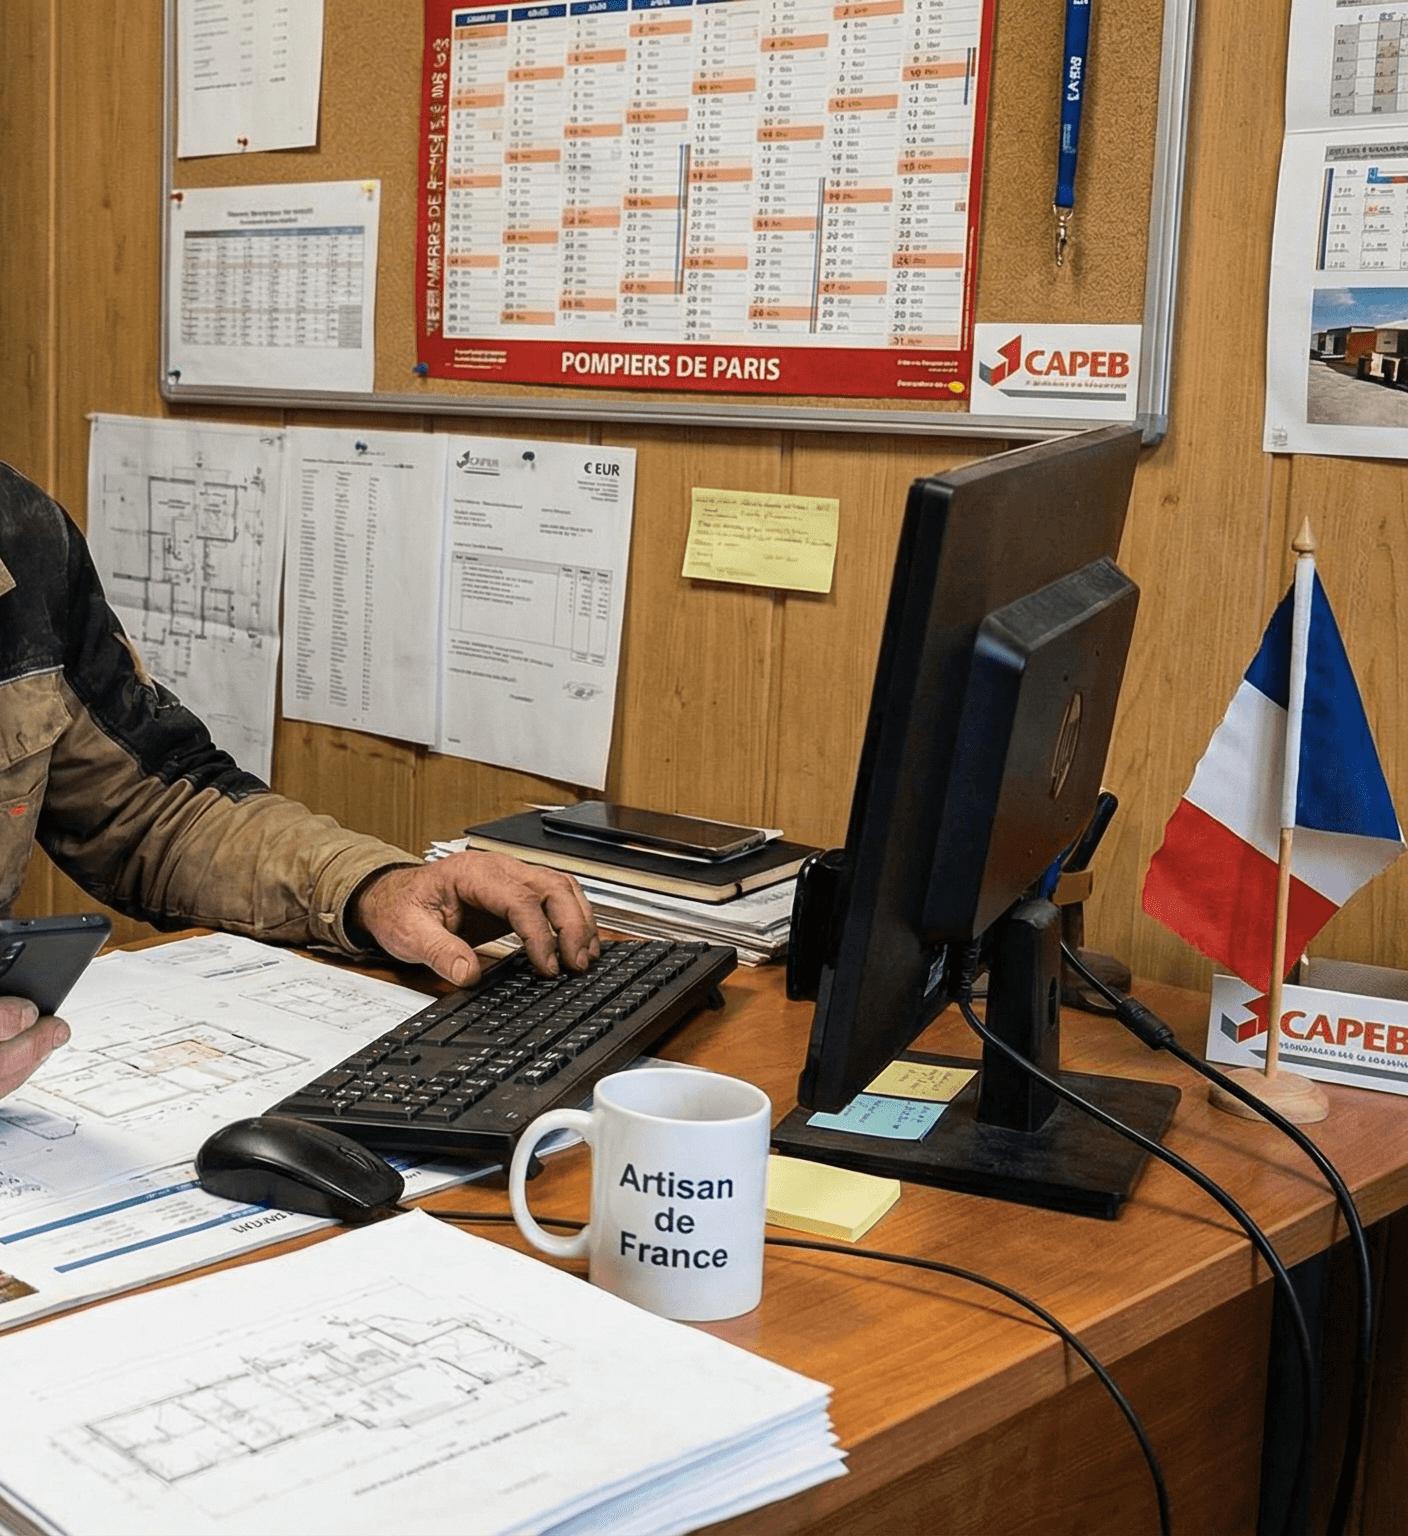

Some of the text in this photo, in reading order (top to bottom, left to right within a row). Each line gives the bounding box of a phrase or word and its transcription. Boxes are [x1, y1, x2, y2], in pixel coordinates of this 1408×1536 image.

[561, 351, 781, 381] POMPIERS DE PARIS
[1024, 349, 1130, 378] CAPEB
[584, 462, 620, 476] € EUR
[1279, 1010, 1408, 1056] CAPEB
[619, 1163, 734, 1200] Artisan
[654, 1207, 695, 1234] de
[620, 1231, 729, 1269] France
